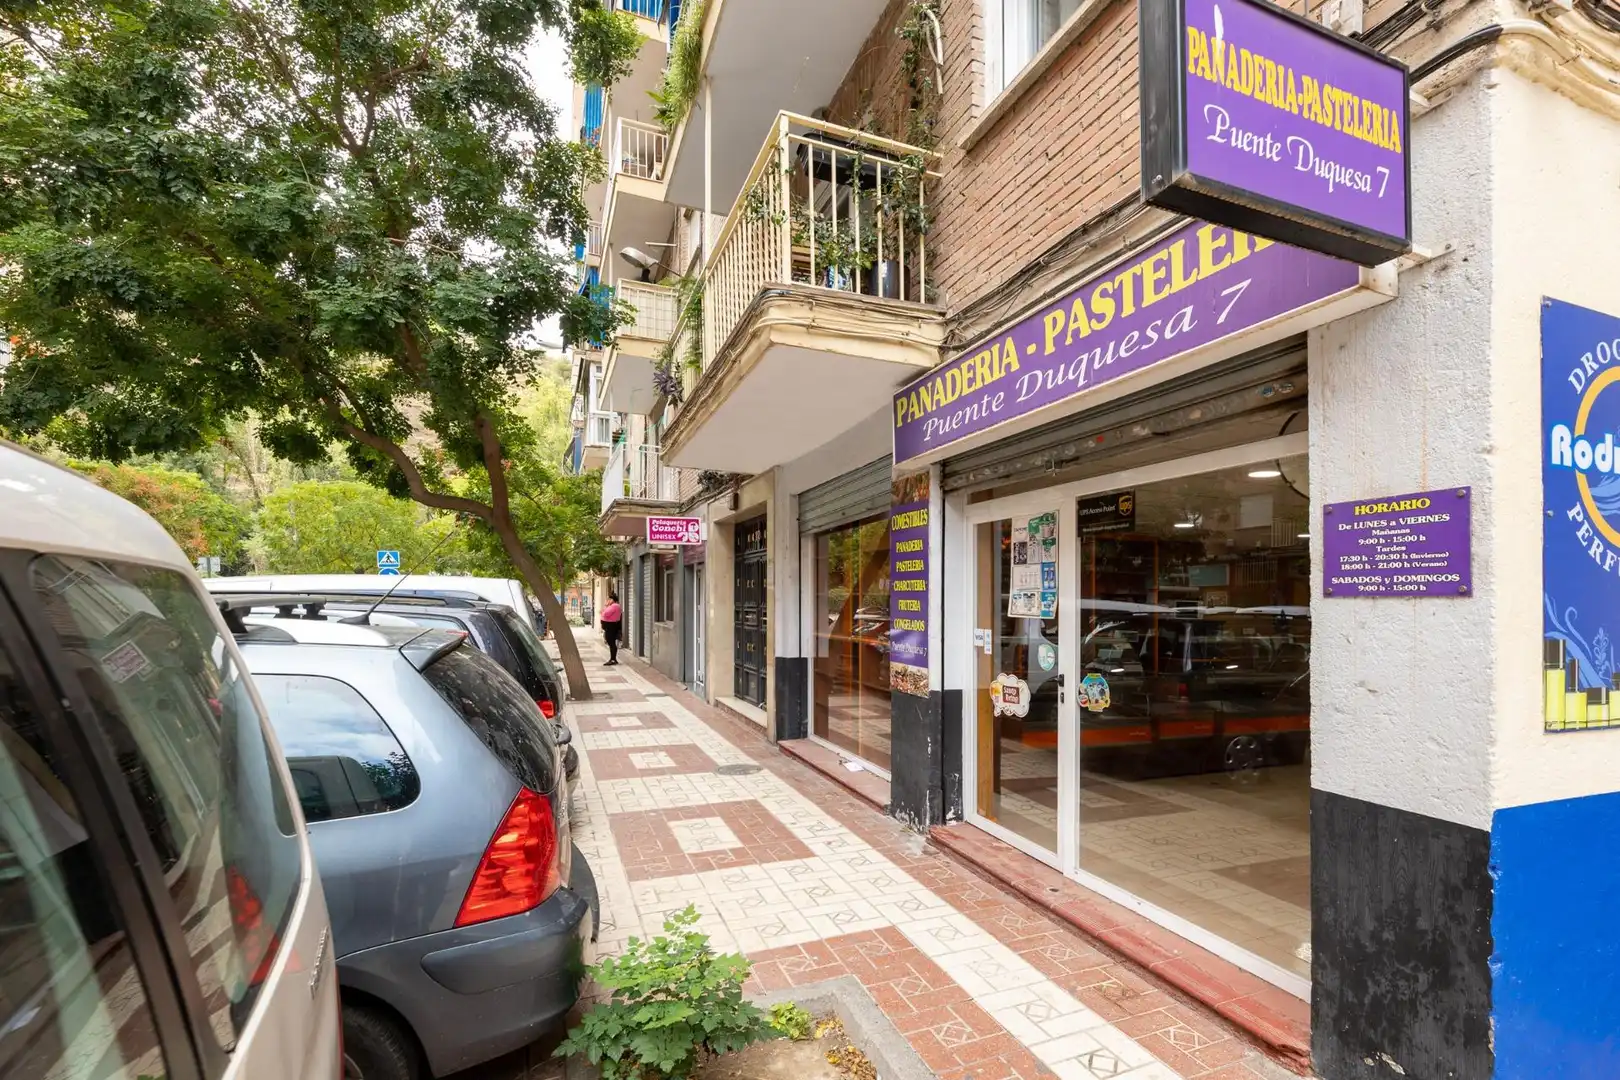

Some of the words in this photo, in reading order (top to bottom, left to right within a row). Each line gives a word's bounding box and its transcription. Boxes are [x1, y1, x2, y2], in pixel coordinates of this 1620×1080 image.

[1203, 104, 1282, 162] Puente
[1287, 136, 1372, 193] Duquesa
[1376, 166, 1390, 198] 7
[923, 391, 1005, 441] Puente
[1015, 304, 1198, 402] Duquesa
[1216, 278, 1252, 325] 7
[896, 336, 1020, 428] PANADERIA
[1354, 498, 1431, 516] HORARIO
[891, 508, 928, 531] COMESTIBLES
[1338, 523, 1352, 531] De
[1353, 519, 1388, 530] LUNES
[1398, 513, 1450, 525] VIERNES
[1358, 537, 1378, 546] 9:00
[1379, 537, 1386, 545] h
[1392, 534, 1418, 543] 15:00
[1419, 533, 1426, 541] h
[1371, 528, 1410, 537] Mañanas
[1567, 501, 1620, 577] PERF
[895, 539, 924, 553] PANADERIA
[1339, 555, 1361, 563] 17:30
[1362, 554, 1368, 562] h
[1374, 553, 1401, 561] 20:30
[1402, 552, 1408, 560] h
[1410, 551, 1449, 560] (Invierno)
[895, 559, 925, 573] PASTELERIA
[1340, 563, 1364, 571] 18:00
[1365, 562, 1371, 570] h
[1377, 561, 1403, 569] 21:00
[1412, 560, 1448, 568] (Verano)
[893, 579, 927, 592] CHARCUTERIA
[1331, 575, 1382, 585] SABADOS
[1384, 577, 1391, 585] y
[1393, 573, 1461, 583] DOMINGOS
[898, 599, 921, 612] FRUTERIA
[893, 618, 926, 632] CONGELADOS
